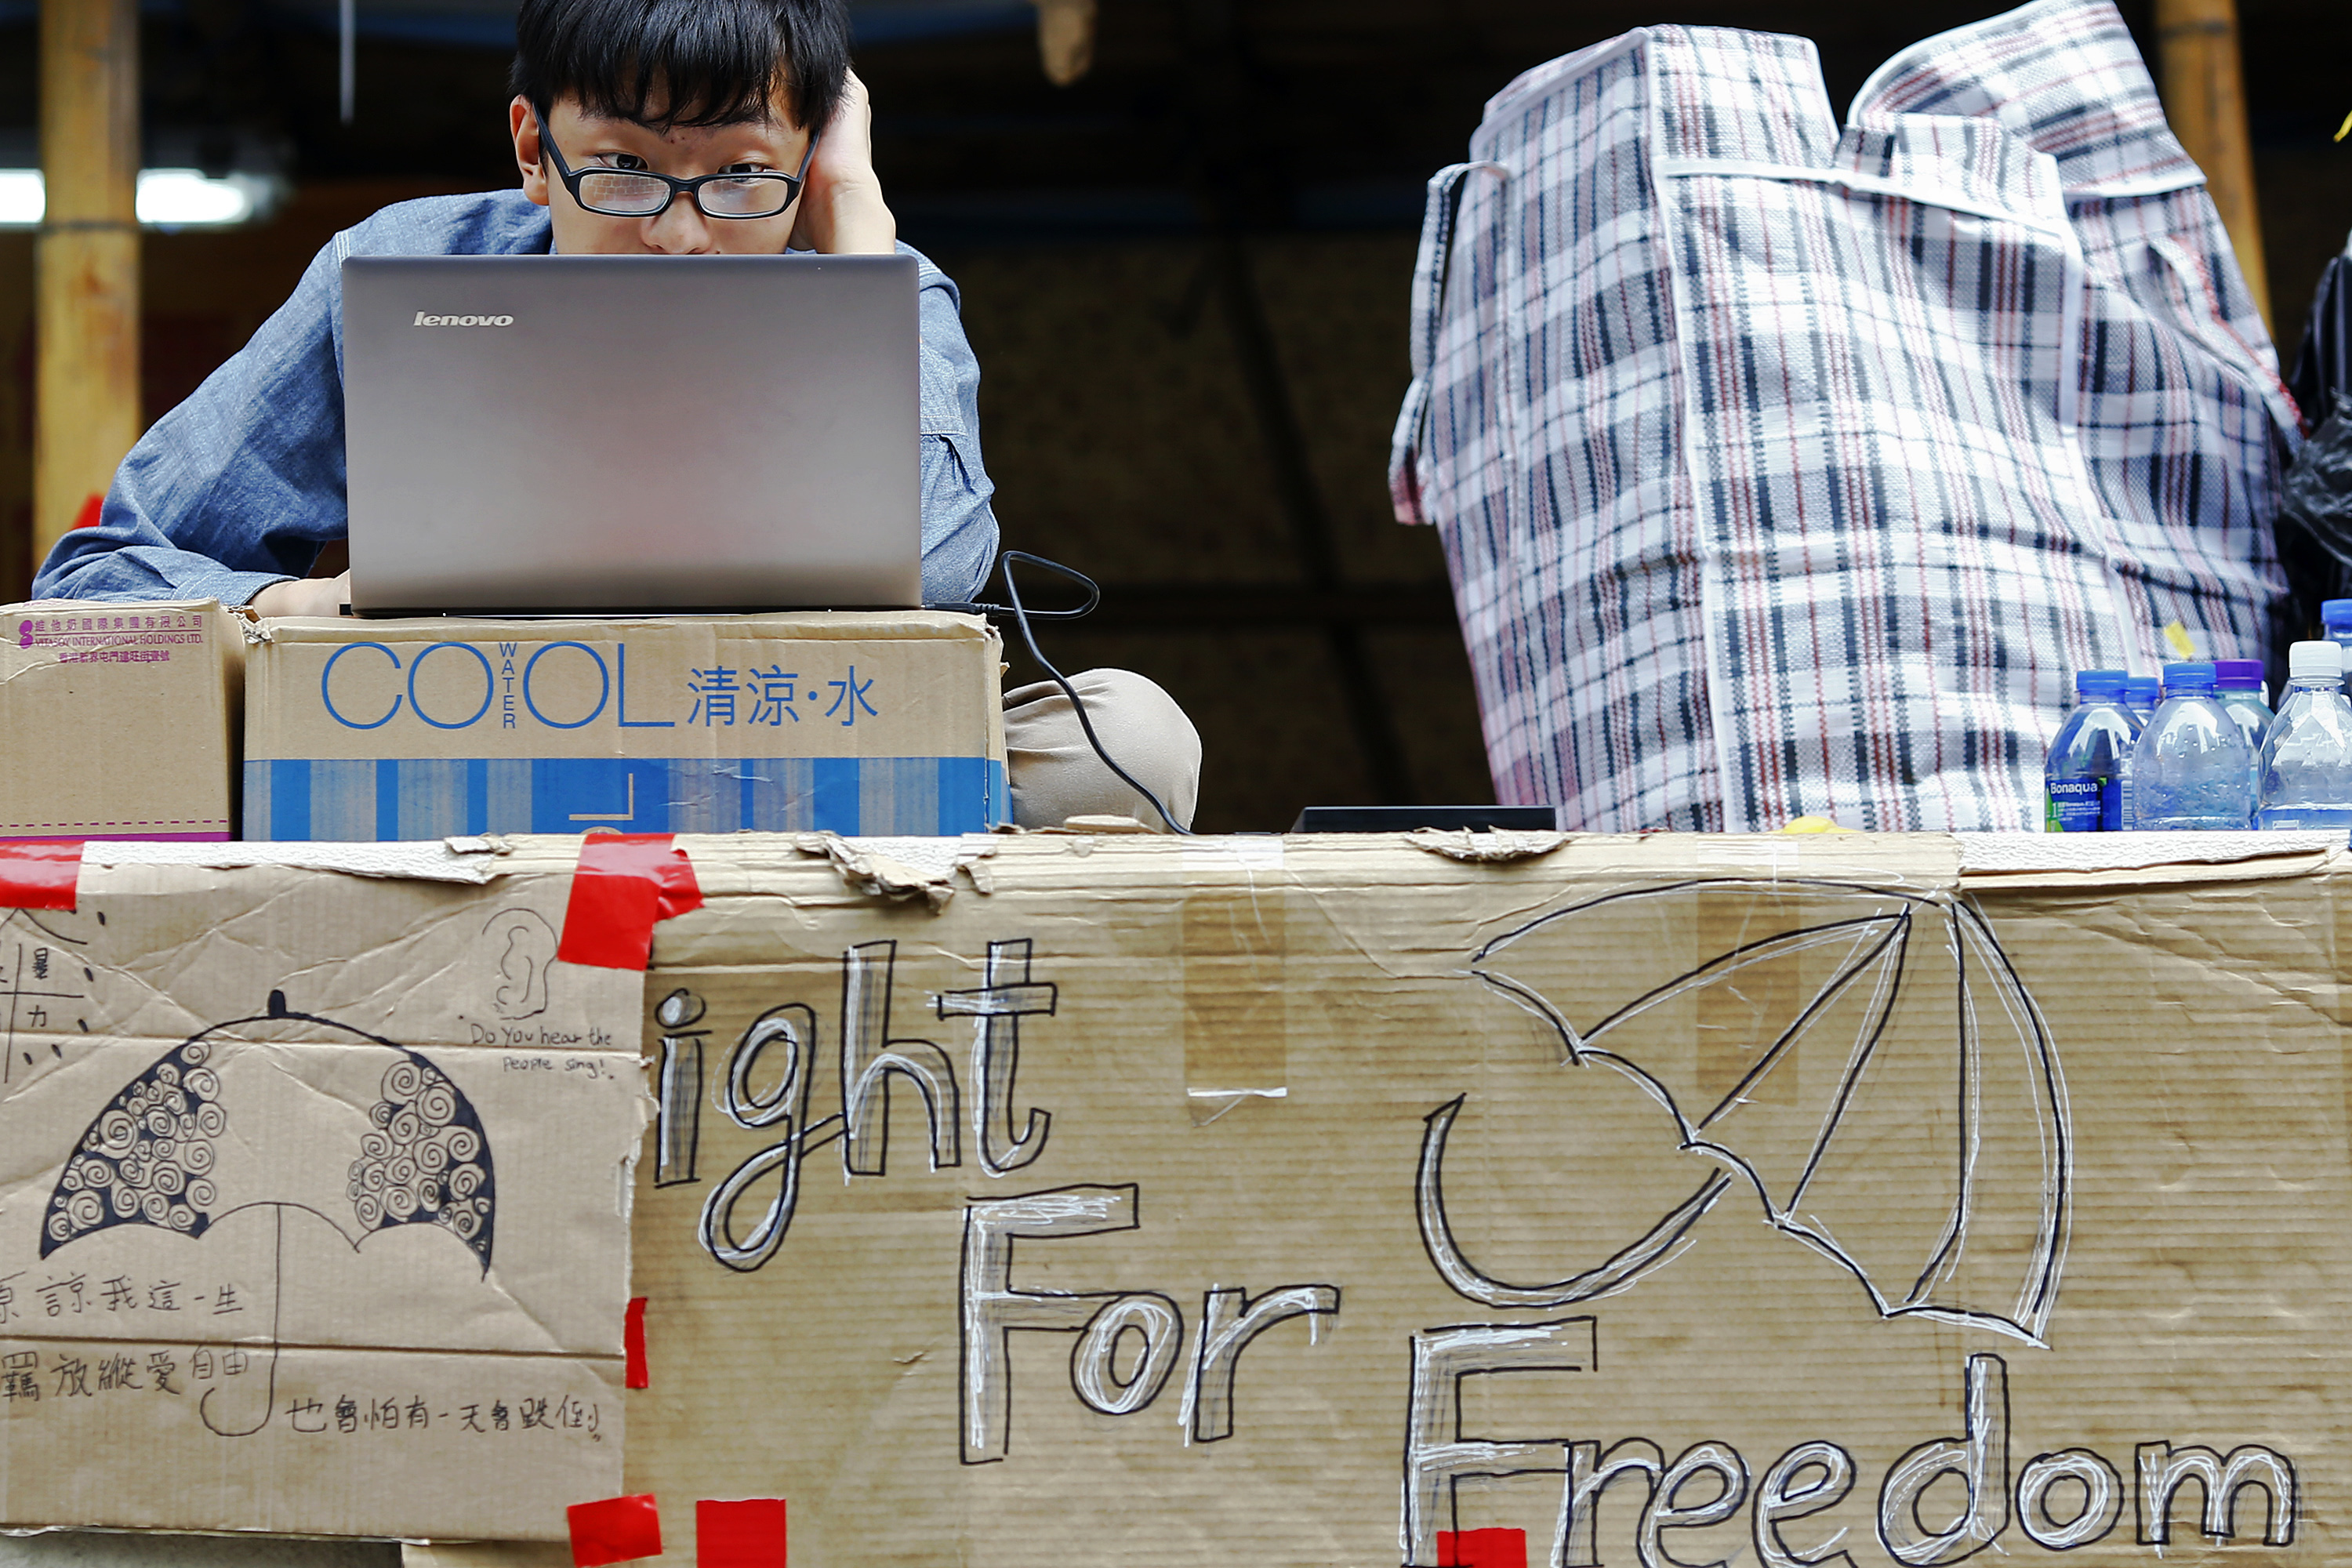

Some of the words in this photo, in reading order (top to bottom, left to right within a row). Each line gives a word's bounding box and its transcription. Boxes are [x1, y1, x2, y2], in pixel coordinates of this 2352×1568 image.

[413, 310, 514, 326] lenovo
[34, 637, 71, 648] VITASOY
[72, 634, 138, 647] INTERNATIONAL
[140, 633, 185, 644] HOLDINGS
[187, 633, 203, 644] LTD.
[35, 615, 202, 632] 維他奶國際集團有限公司
[321, 641, 675, 730] COOL
[499, 641, 517, 729] WATER
[2050, 782, 2098, 795] Bonaqua
[471, 1023, 496, 1044] Do
[539, 1025, 582, 1046] hear
[589, 1026, 612, 1046] the
[648, 937, 1058, 1273] ight
[959, 1183, 1341, 1465] For
[1399, 1316, 2299, 1568] Freedom
